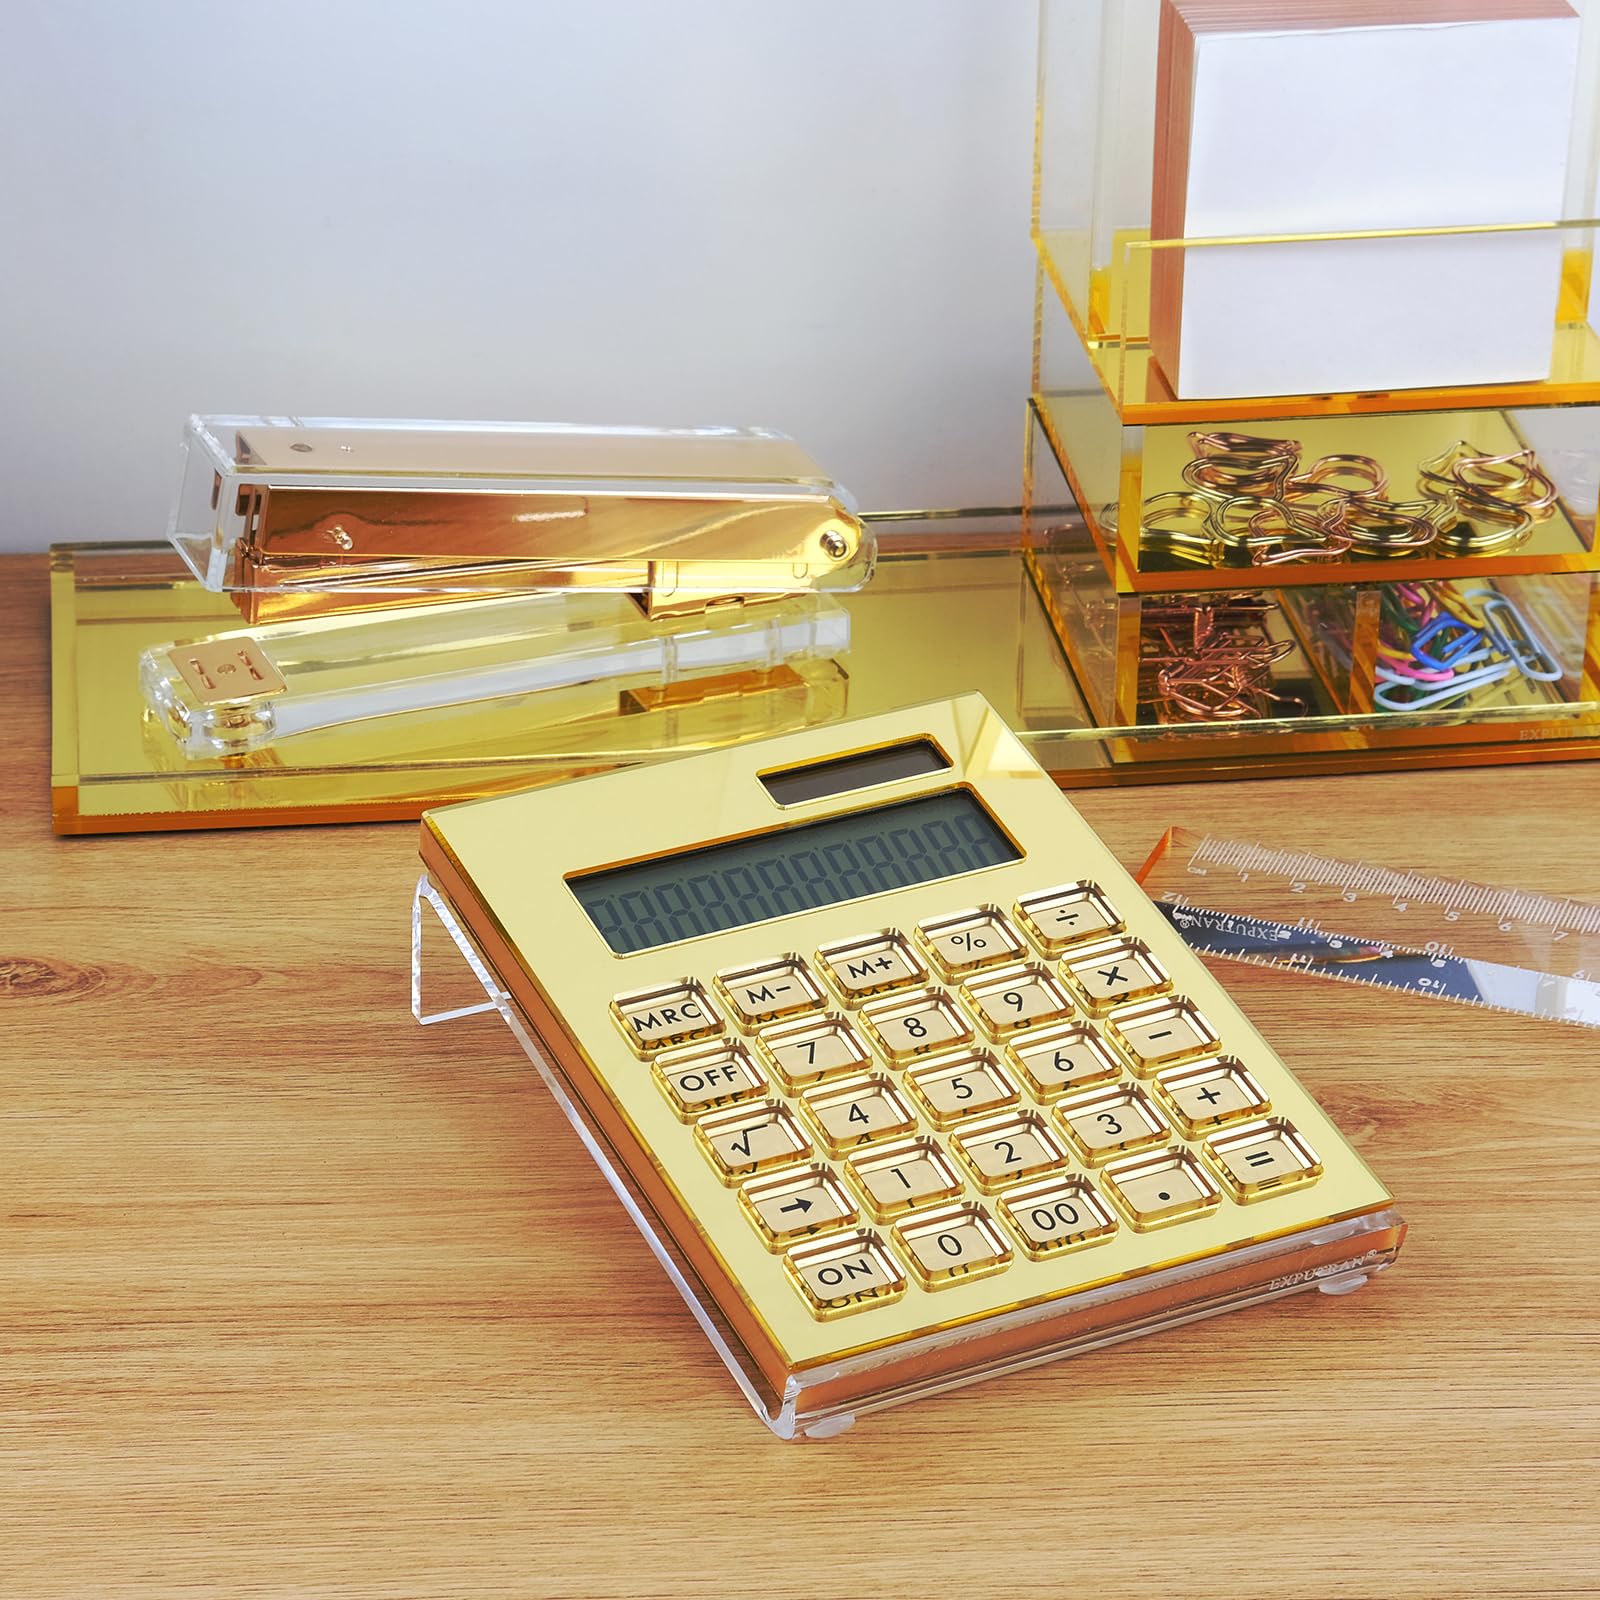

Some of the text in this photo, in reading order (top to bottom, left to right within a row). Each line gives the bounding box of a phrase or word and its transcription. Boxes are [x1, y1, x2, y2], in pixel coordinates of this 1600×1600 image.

[1240, 873, 1249, 883] 1
[1291, 882, 1306, 894] 2
[1343, 892, 1357, 903] 3
[1393, 902, 1408, 913] 4
[1444, 911, 1461, 922] 5
[1498, 922, 1512, 932] 6
[1553, 931, 1569, 941] 7
[1424, 941, 1448, 955] 10
[634, 1003, 702, 1033] MRC
[747, 986, 790, 1003] M-
[848, 958, 892, 978] M+
[951, 933, 986, 951] %
[680, 1065, 739, 1092] OFF
[797, 1042, 815, 1064] 7
[904, 1018, 927, 1037] 8
[1004, 993, 1022, 1011] 9
[849, 1104, 868, 1123] 4
[952, 1078, 972, 1098] 5
[1055, 1052, 1073, 1071] 6
[891, 1088, 1220, 1188] 1 2 3 +
[818, 1260, 872, 1285] ON
[938, 1235, 962, 1255] 0
[1031, 1203, 1081, 1232] 00
[1246, 1152, 1274, 1167] =
